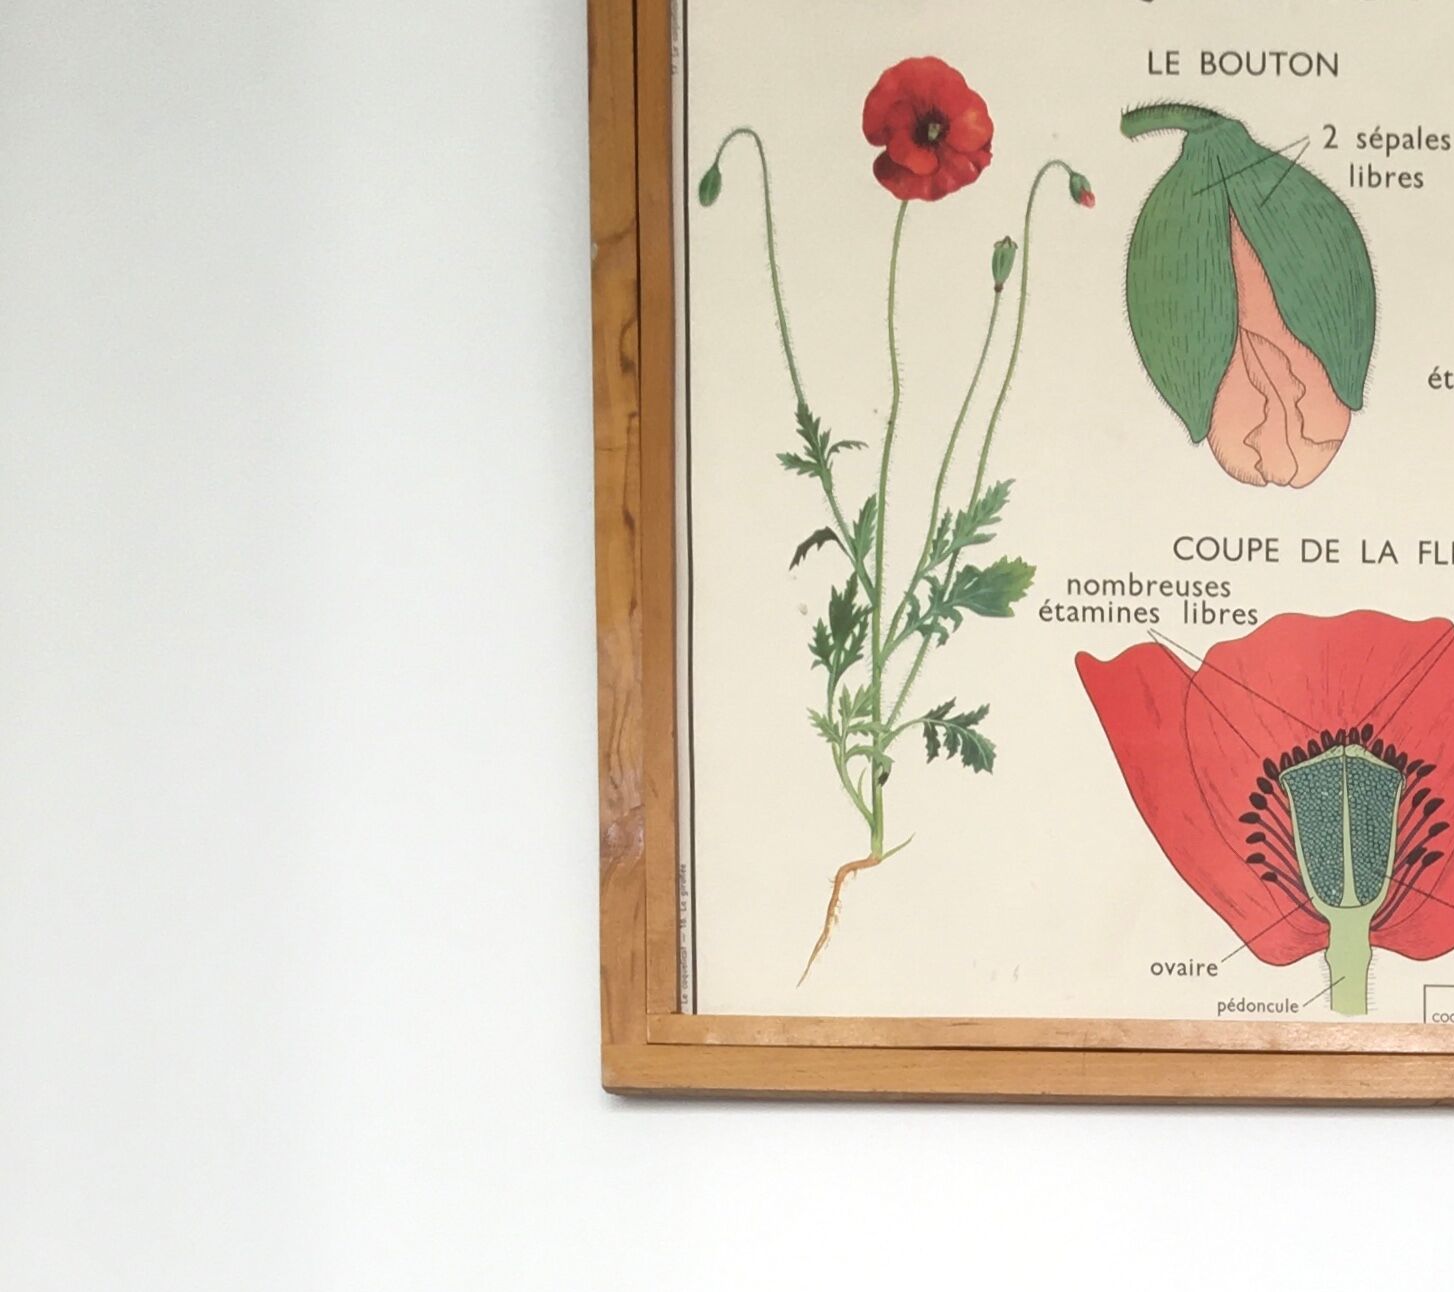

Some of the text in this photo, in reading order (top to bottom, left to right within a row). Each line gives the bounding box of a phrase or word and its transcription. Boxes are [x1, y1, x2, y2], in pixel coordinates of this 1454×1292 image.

[1148, 51, 1339, 78] LE BOUTON
[1322, 124, 1451, 155] 2 sépales
[1349, 164, 1424, 189] libres
[1172, 536, 1280, 563] COUPE
[1301, 539, 1340, 564] DE
[1361, 540, 1399, 565] LA
[1067, 572, 1231, 598] nombreuses
[1038, 598, 1259, 625] étamines libres
[1150, 958, 1218, 977] ovaire
[1217, 997, 1299, 1015] pédoncule
